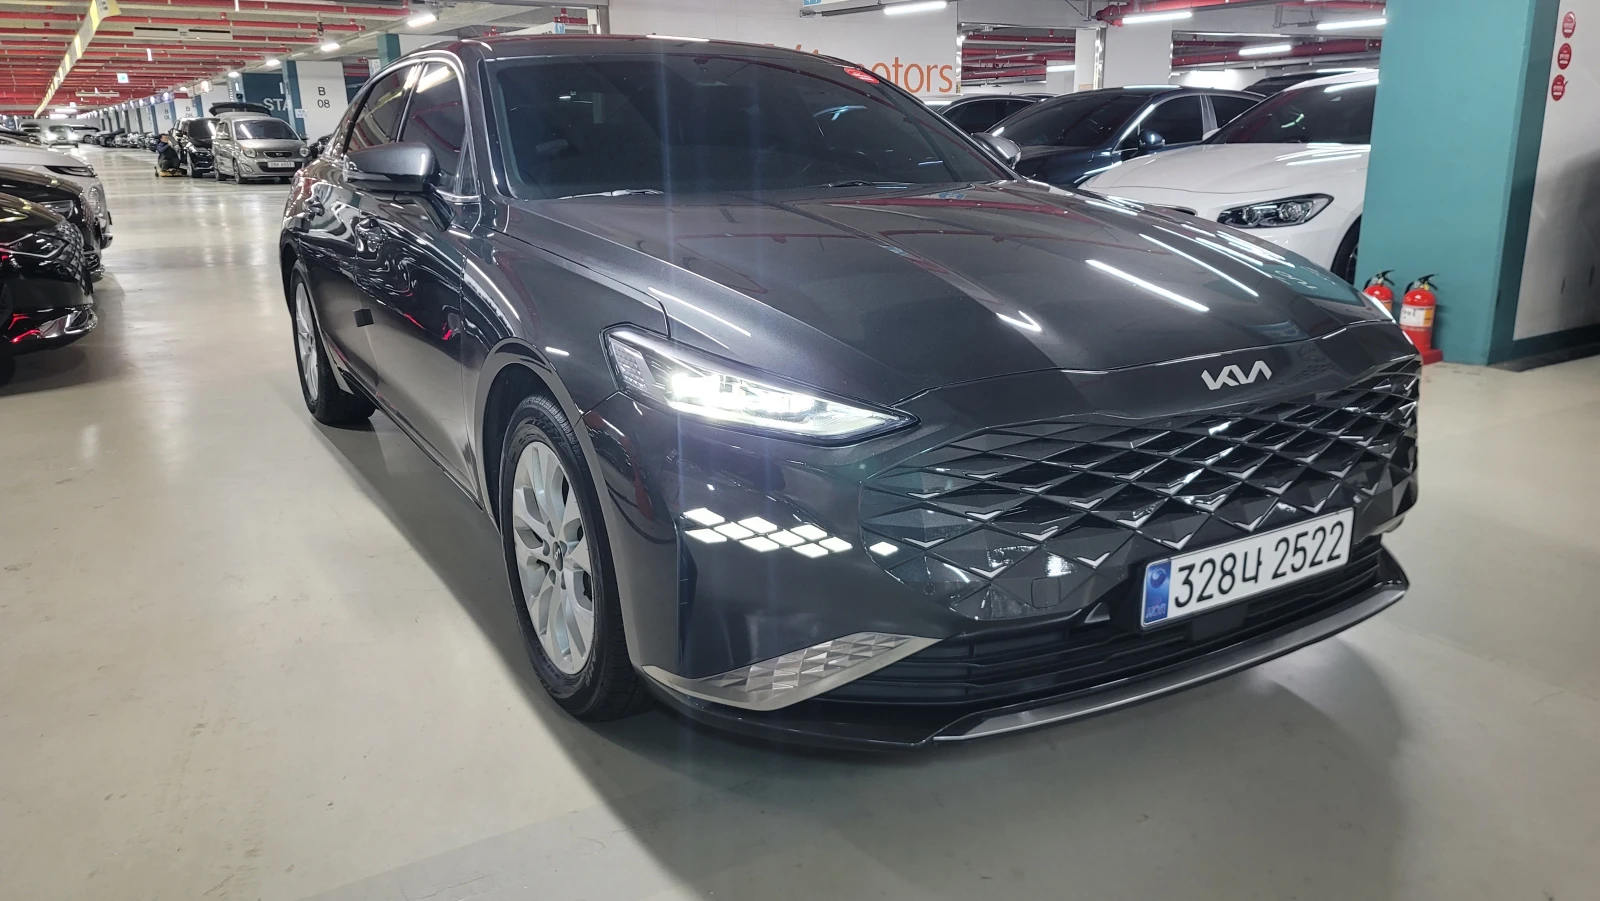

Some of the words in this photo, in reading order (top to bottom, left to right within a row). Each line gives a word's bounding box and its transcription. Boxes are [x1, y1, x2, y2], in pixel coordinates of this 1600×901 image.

[317, 86, 327, 96] B
[857, 57, 954, 94] otors
[317, 99, 331, 109] 08
[1201, 360, 1272, 391] KIA
[1174, 547, 1263, 609] 328나
[1271, 520, 1345, 581] 2522
